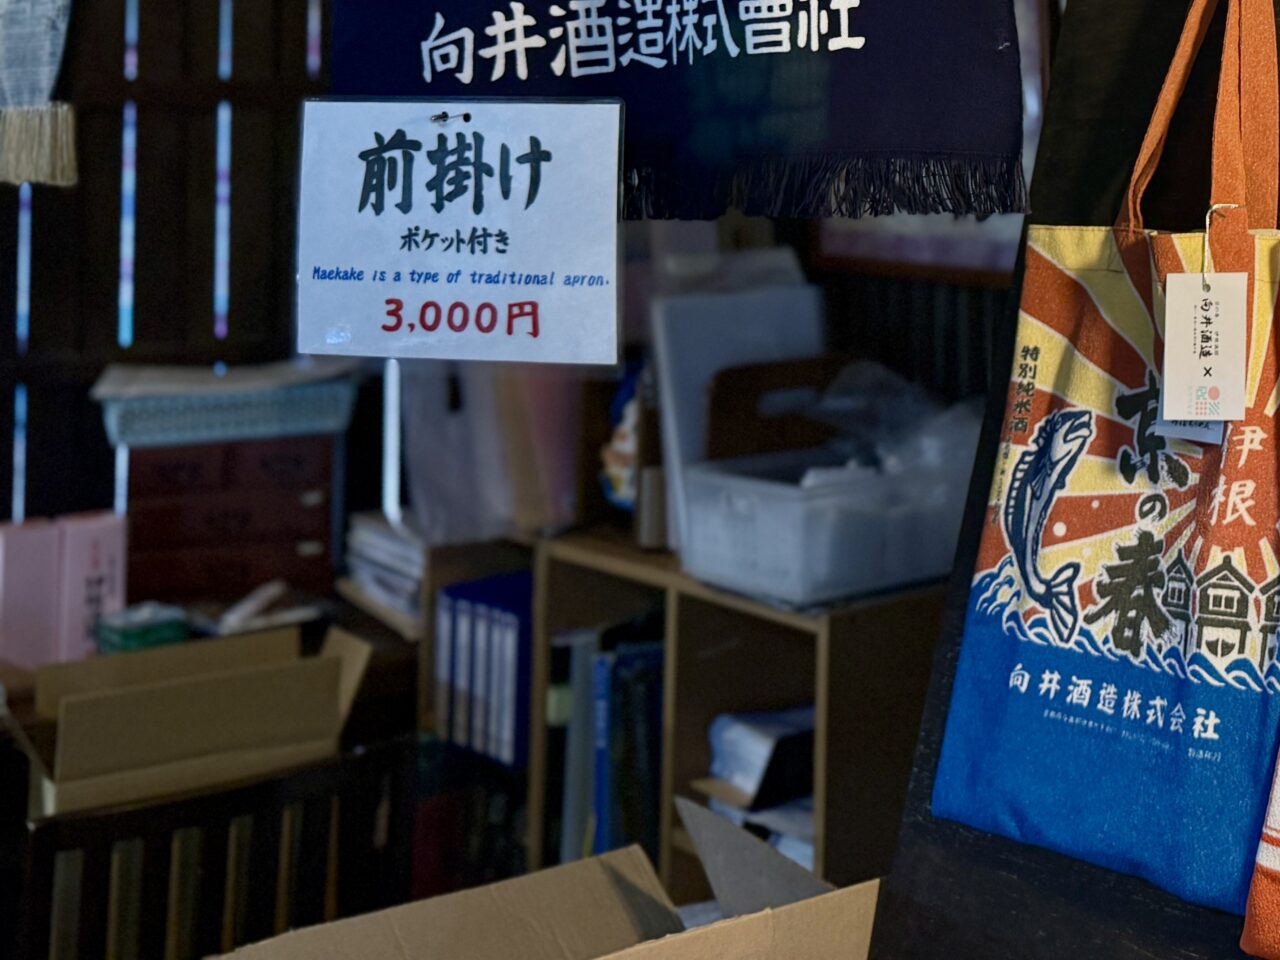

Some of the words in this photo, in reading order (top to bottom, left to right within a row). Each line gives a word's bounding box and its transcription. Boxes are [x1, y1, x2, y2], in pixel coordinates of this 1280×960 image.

[357, 128, 553, 216] 前掛け
[400, 225, 510, 255] ポケット付き
[312, 267, 364, 282] Maekake
[372, 268, 386, 282] is
[393, 271, 401, 283] a
[409, 269, 440, 284] type
[446, 269, 462, 284] of
[470, 271, 554, 286] traditional
[563, 275, 610, 288] apron.
[381, 298, 540, 338] 3,000円
[1009, 345, 1041, 433] 特別純米酒
[1008, 662, 1223, 741] 向井酒造株式会社
